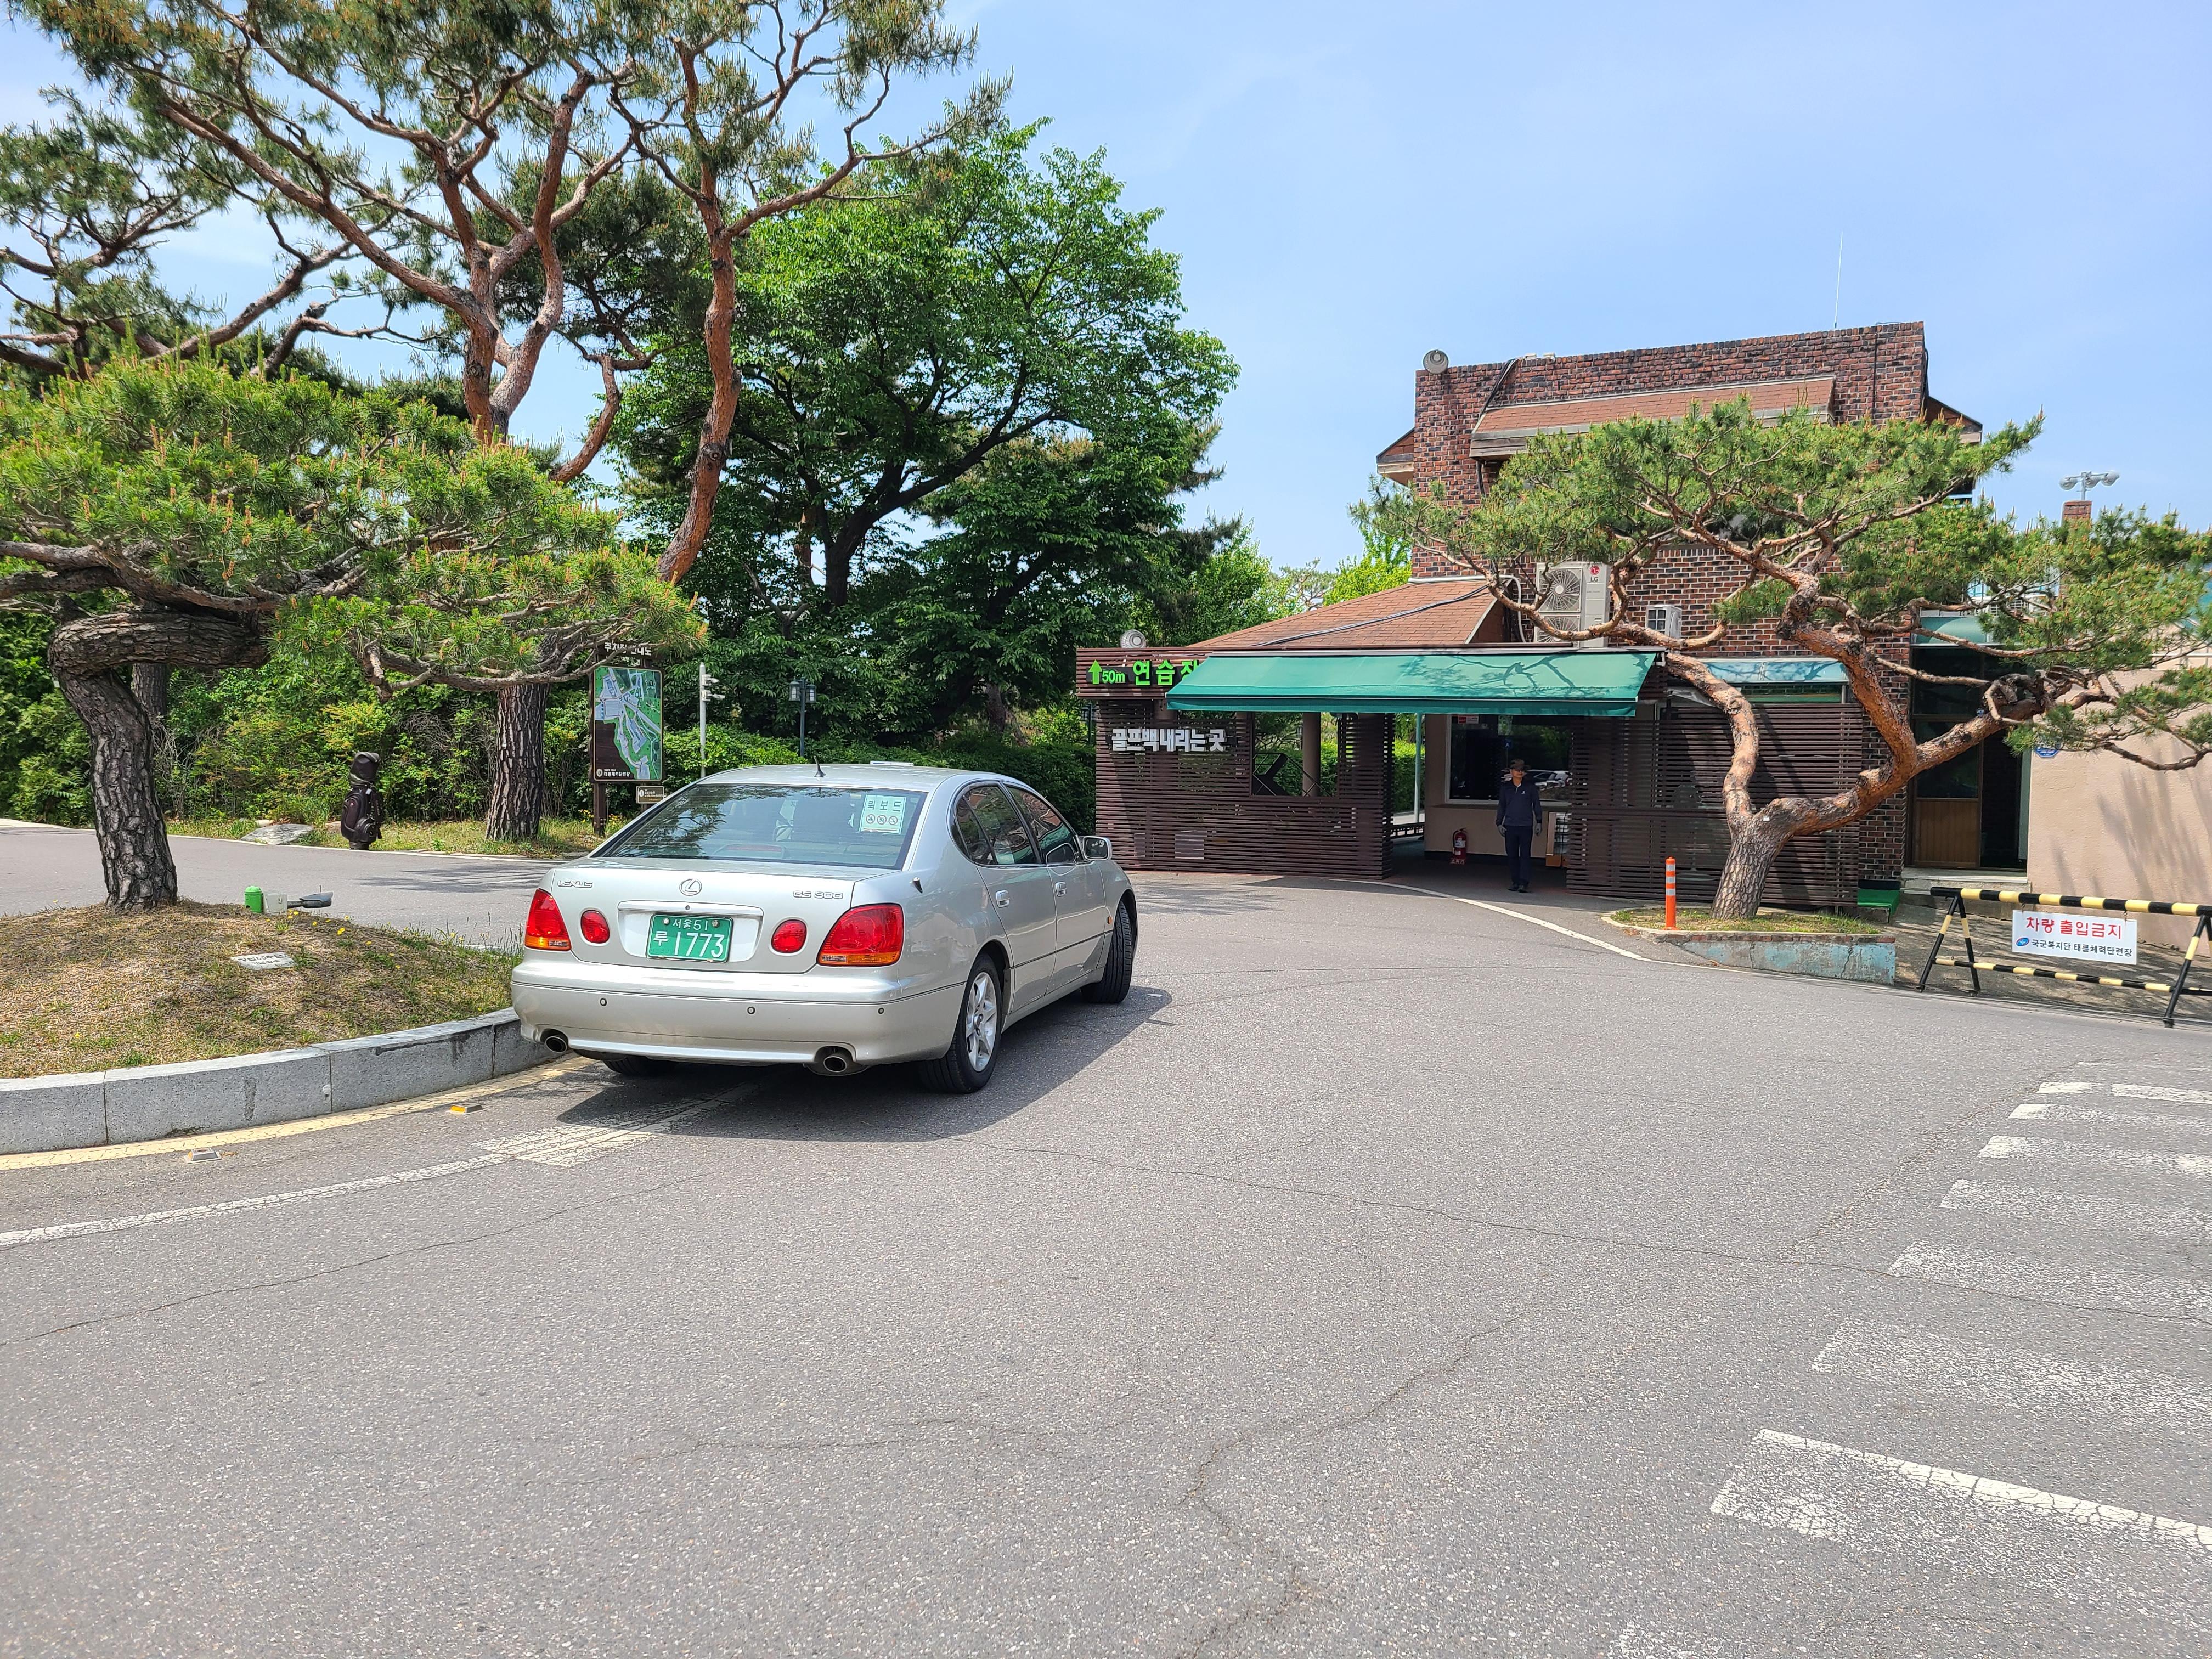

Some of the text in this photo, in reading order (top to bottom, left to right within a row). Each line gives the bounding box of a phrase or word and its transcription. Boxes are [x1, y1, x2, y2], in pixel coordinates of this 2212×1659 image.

[1102, 670, 1126, 684] 50m
[557, 880, 593, 888] LEXUS
[793, 890, 812, 899] GS
[2026, 917, 2121, 939] 차량 출입금지
[2032, 939, 2133, 957] 국군복지단 태릉체력단련장
